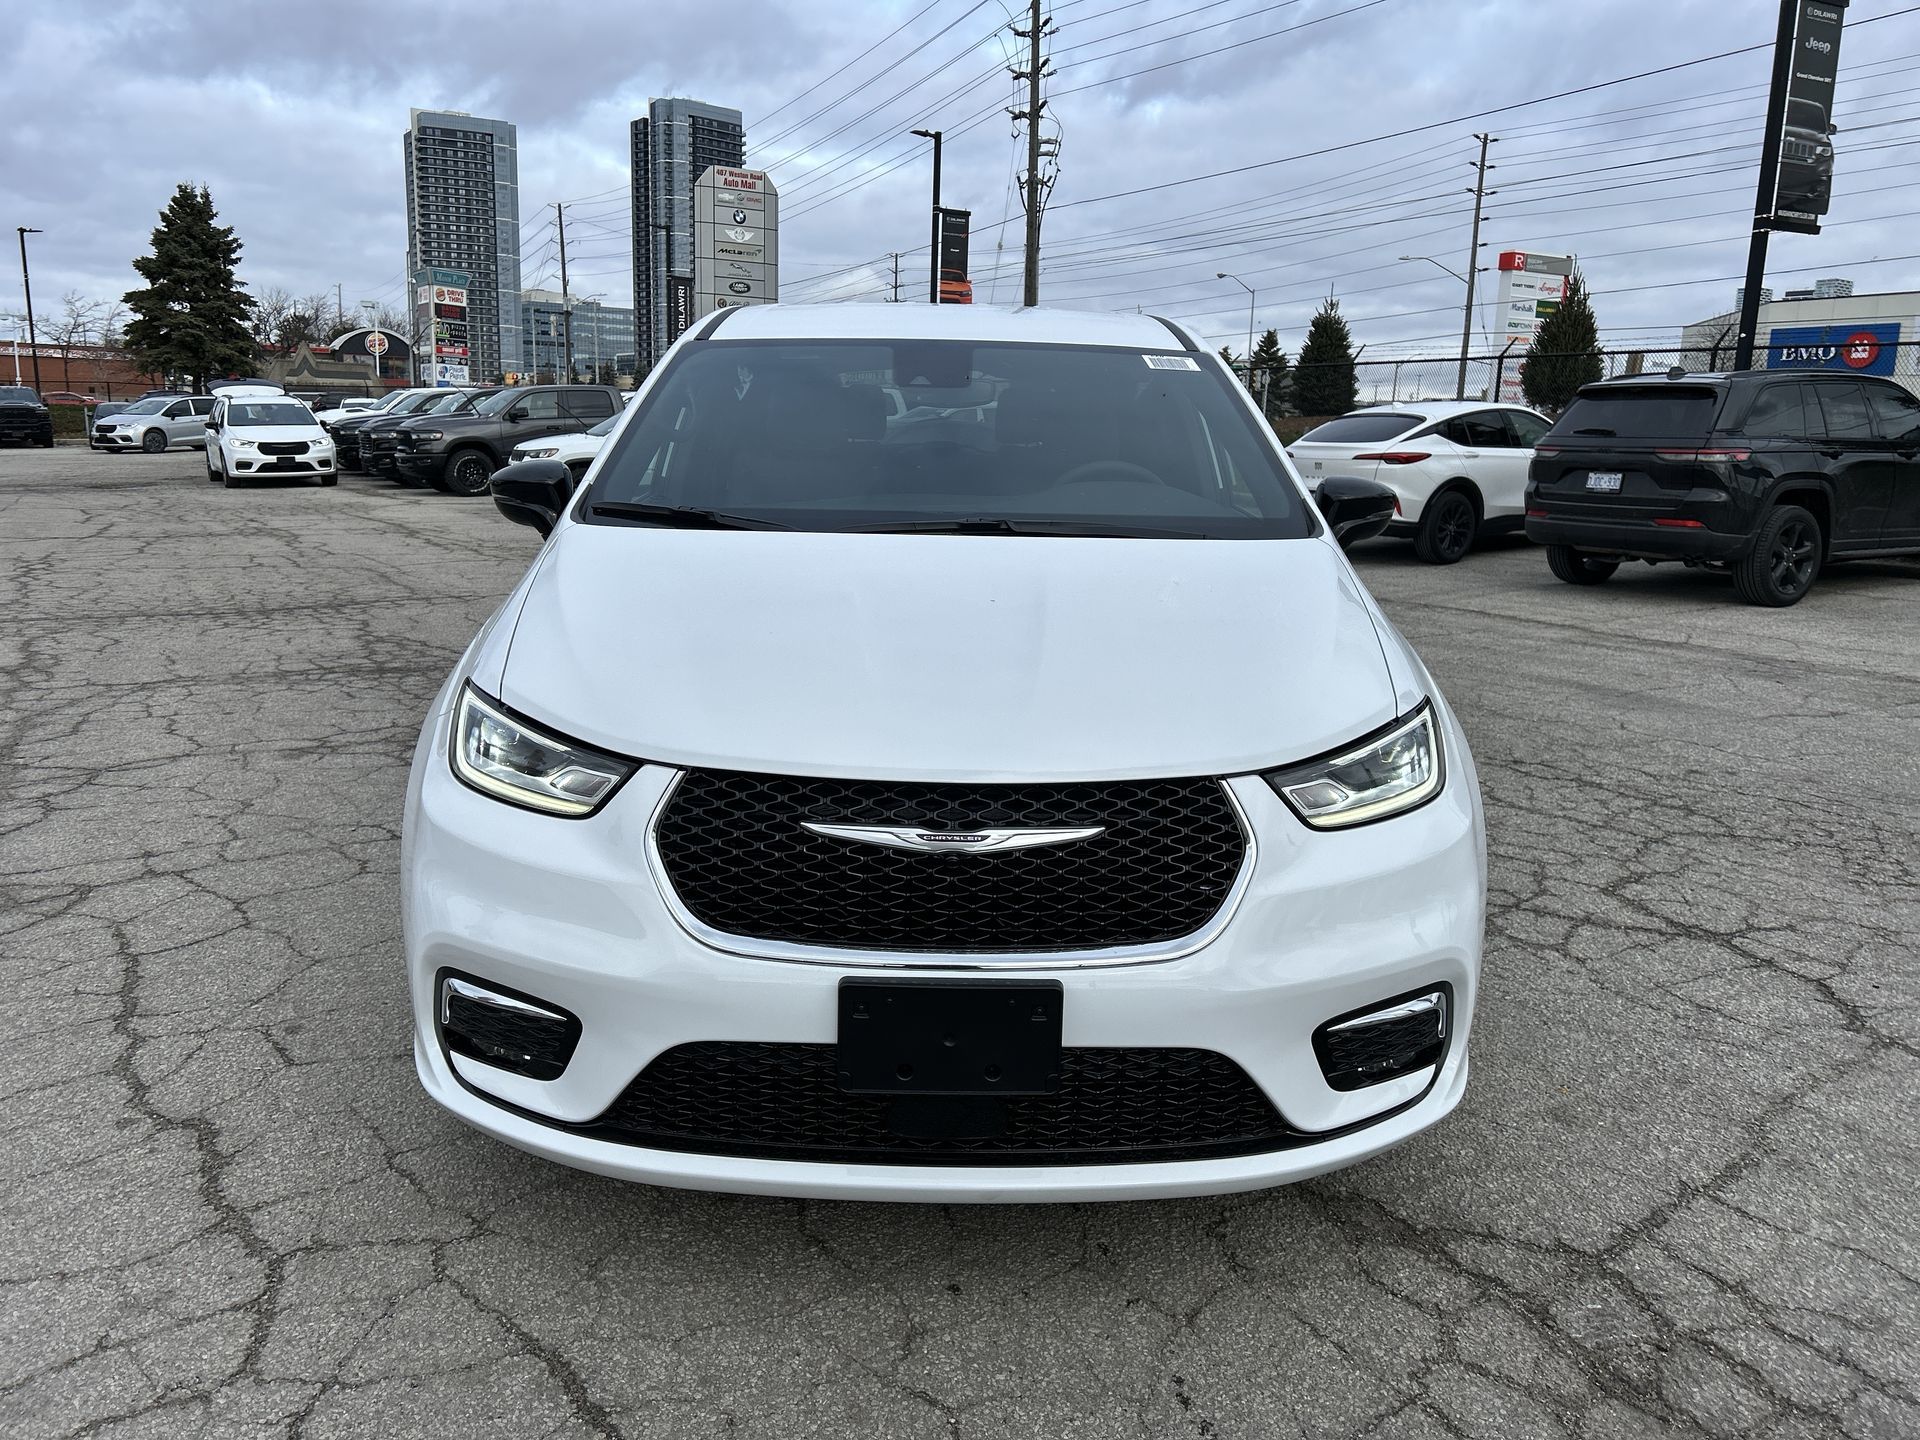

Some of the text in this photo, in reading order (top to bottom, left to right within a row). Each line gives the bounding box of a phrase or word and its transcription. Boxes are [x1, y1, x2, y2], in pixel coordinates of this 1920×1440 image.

[1813, 9, 1838, 20] DILAWRI
[1805, 36, 1831, 54] Jeep
[729, 170, 749, 179] Weston
[750, 173, 763, 181] Road
[723, 177, 757, 190] Auto Mall
[717, 248, 758, 257] McLaren
[1514, 254, 1524, 267] R
[447, 289, 465, 298] DRIVE
[448, 296, 464, 304] THRU
[678, 286, 686, 329] DILAWRI
[1780, 343, 1837, 361] BMO
